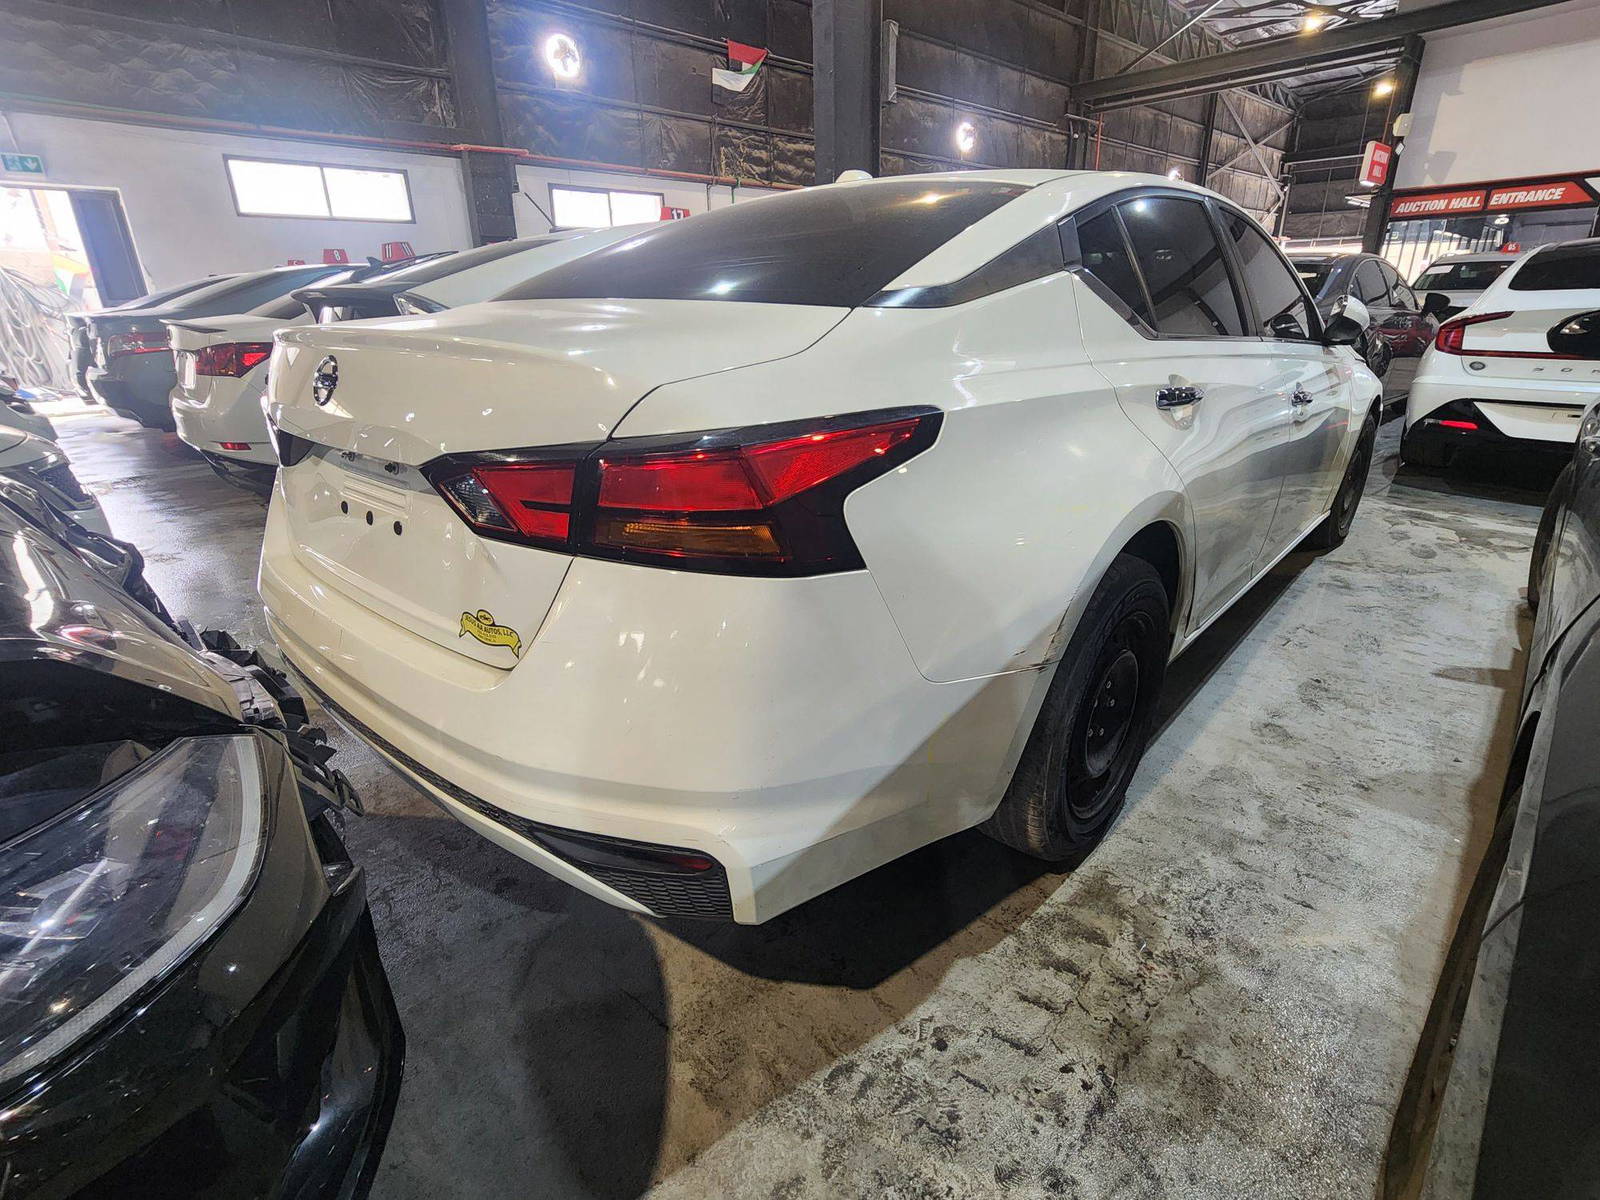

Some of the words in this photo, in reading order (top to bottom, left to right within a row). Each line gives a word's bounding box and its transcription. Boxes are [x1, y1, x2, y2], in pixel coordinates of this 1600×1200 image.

[1394, 198, 1446, 214] AUCTION
[1449, 196, 1481, 210] HALL
[1490, 188, 1567, 206] ENTRANCE
[503, 629, 514, 638] LLC
